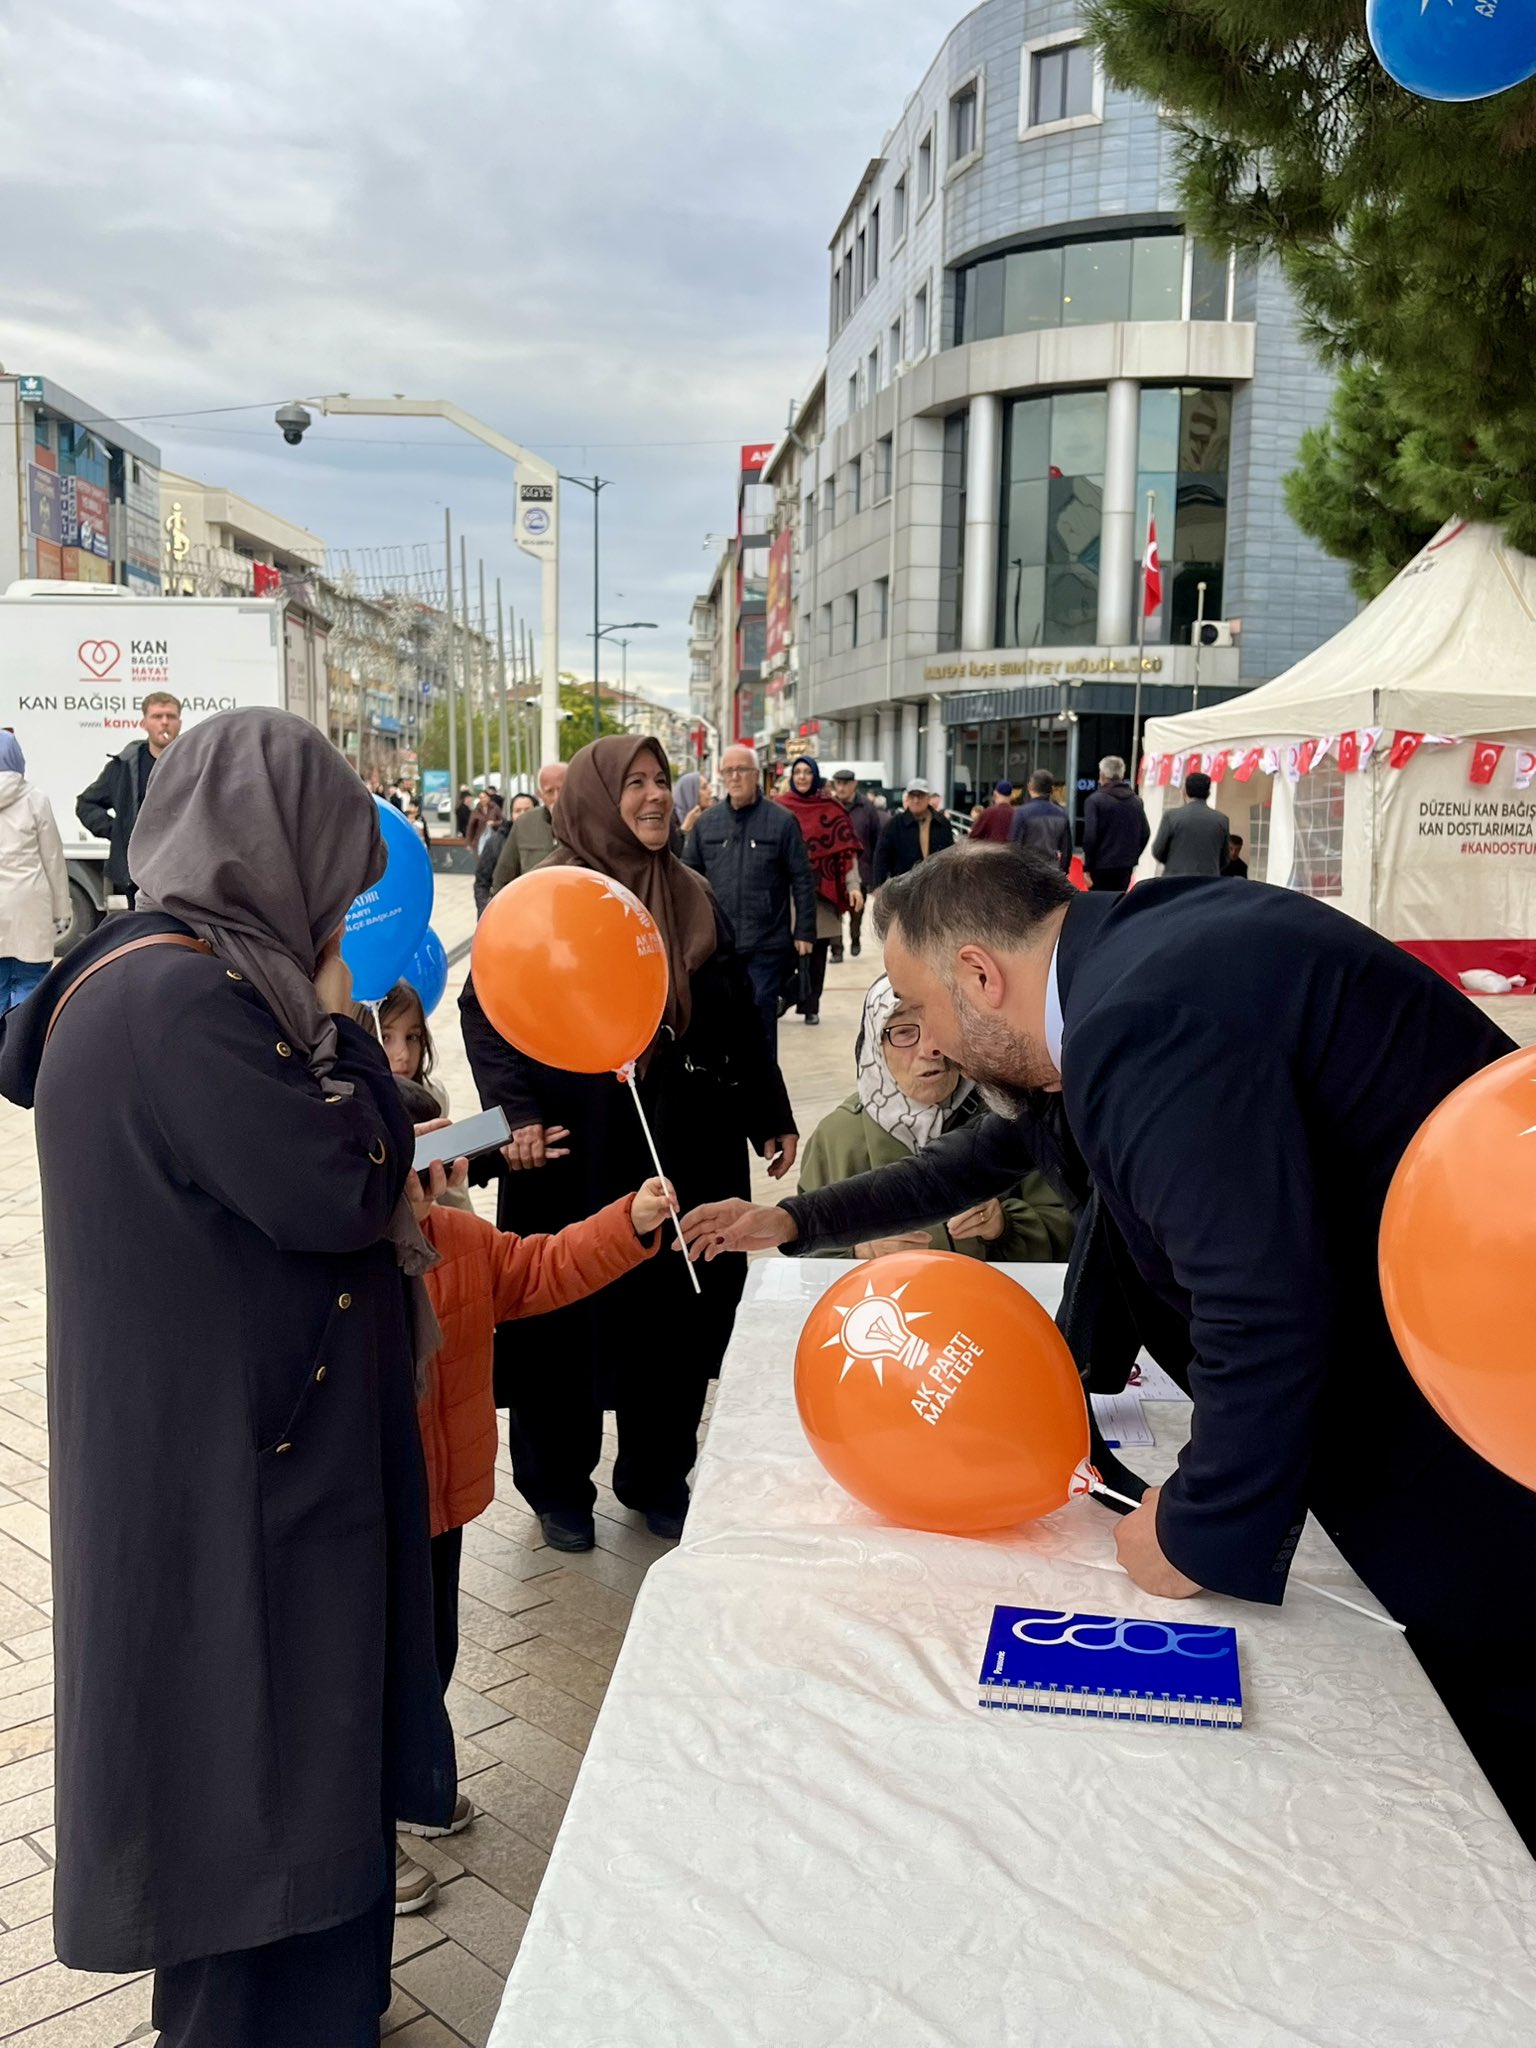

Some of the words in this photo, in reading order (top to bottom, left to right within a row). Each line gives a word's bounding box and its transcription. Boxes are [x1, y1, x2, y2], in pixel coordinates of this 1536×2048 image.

[131, 640, 167, 654] KAN
[131, 655, 169, 665] BAĞIŞI
[131, 667, 169, 676] HAYAT
[19, 696, 57, 710] KAN
[64, 692, 126, 714] BAĞIŞI
[1420, 799, 1471, 816] DÜZENLİ
[1474, 803, 1498, 816] KAN
[1419, 822, 1443, 836] KAN
[1447, 822, 1533, 837] DOSTLARIMIZA
[910, 1381, 937, 1416] AK
[928, 1331, 972, 1384] PARTİ
[923, 1342, 984, 1426] MALTEPE
